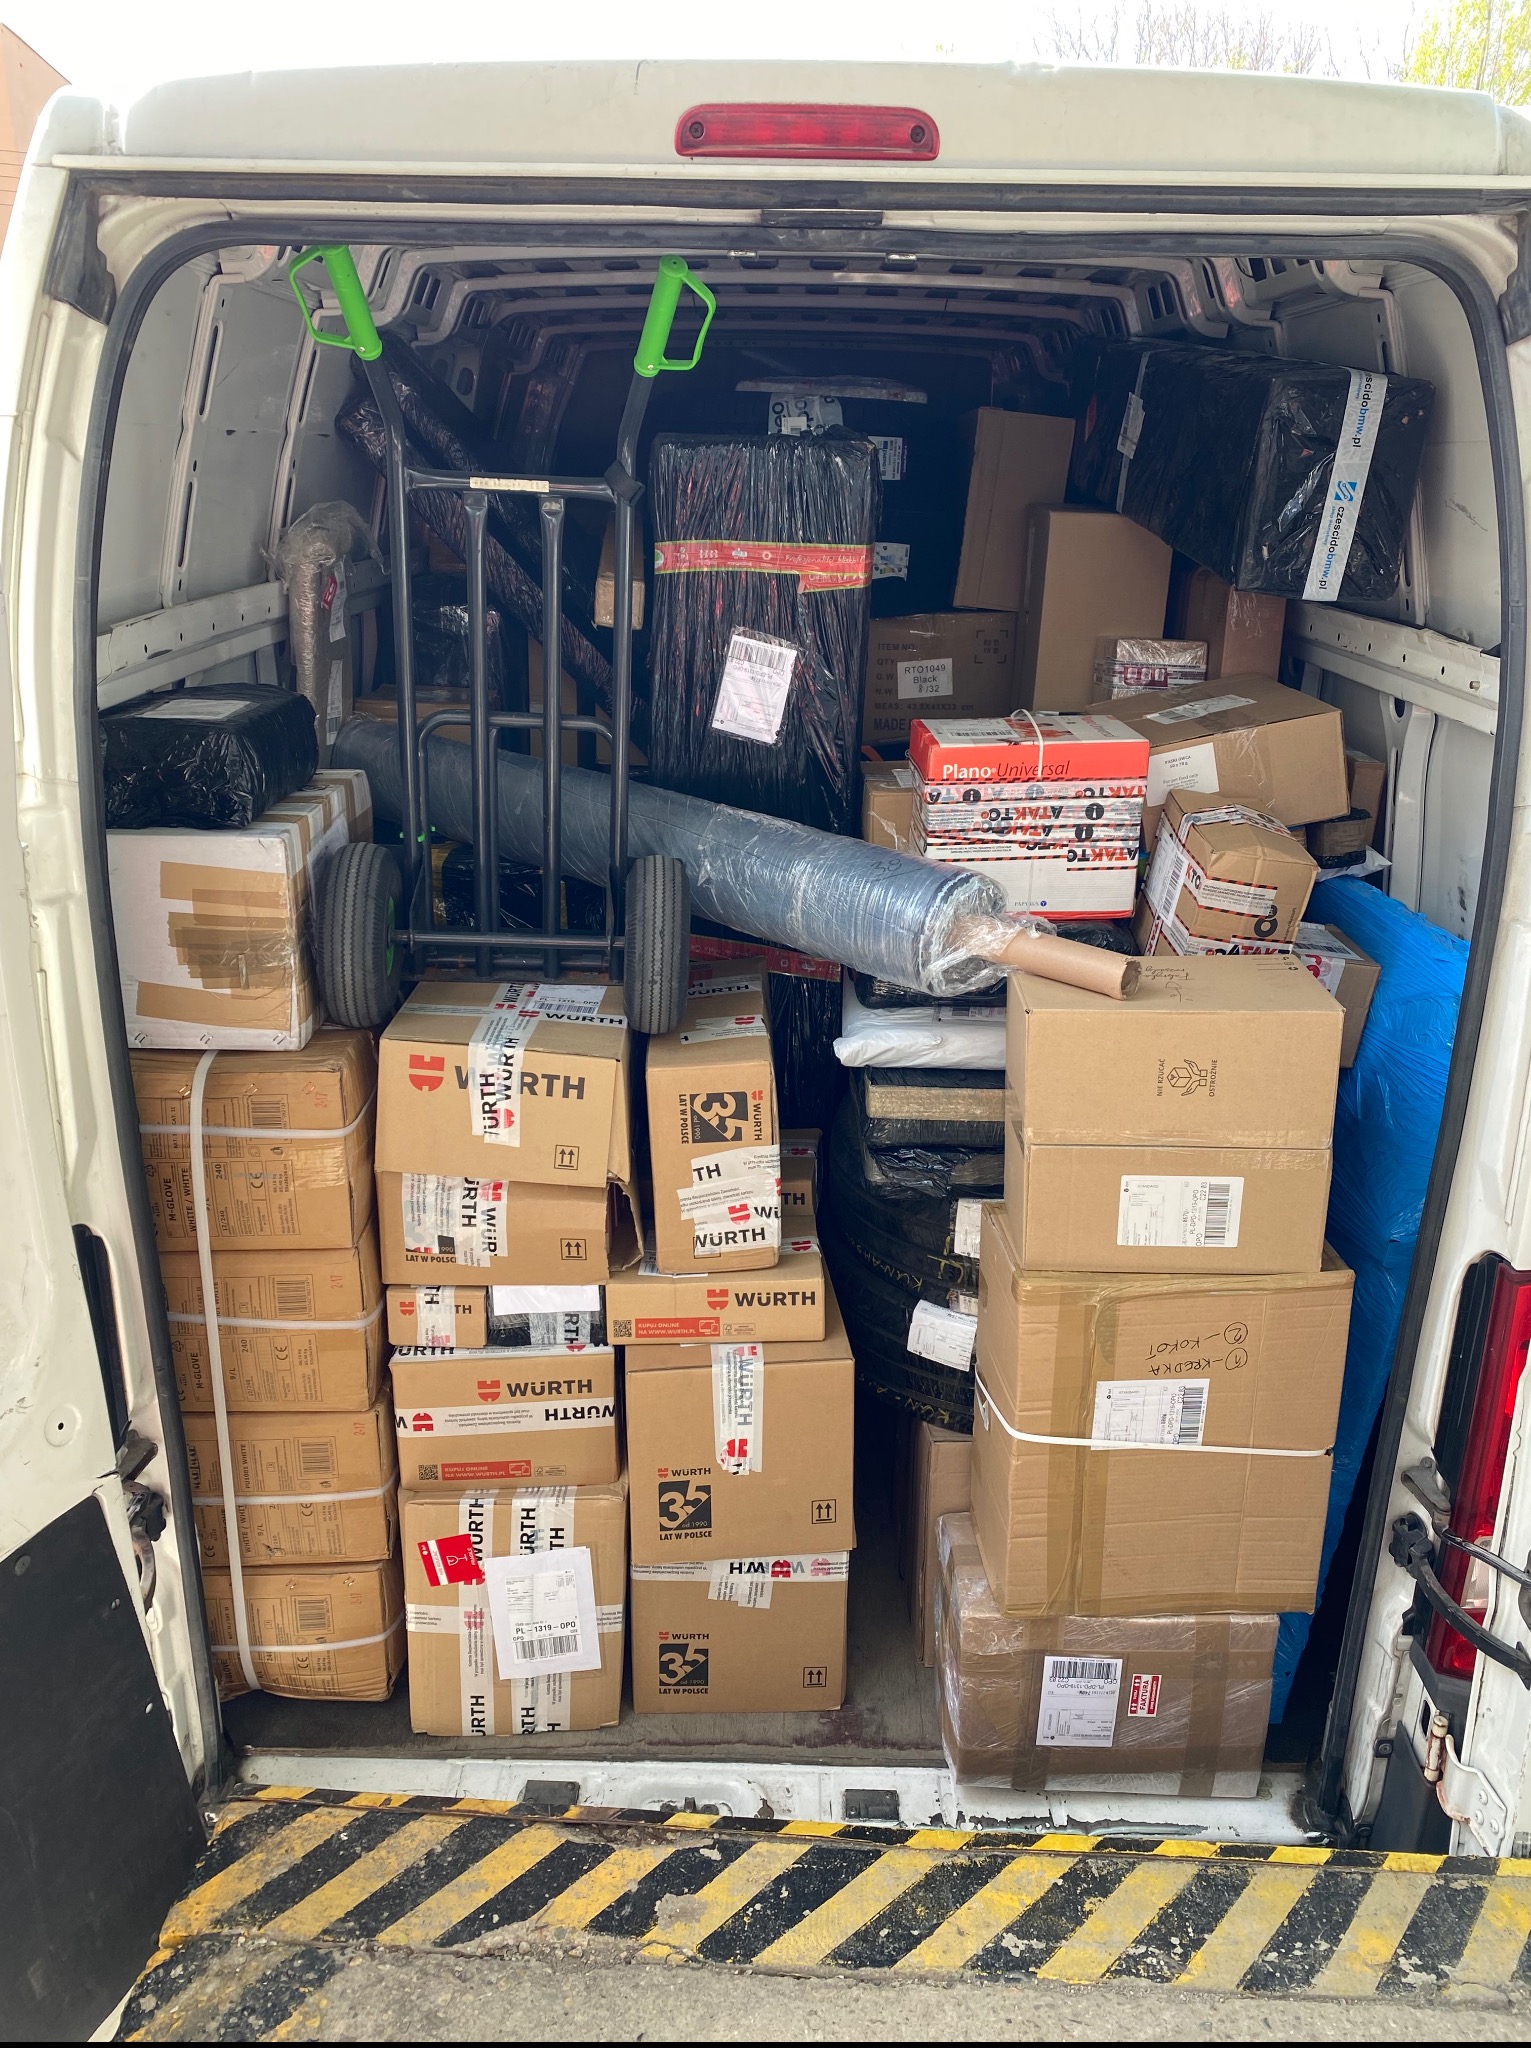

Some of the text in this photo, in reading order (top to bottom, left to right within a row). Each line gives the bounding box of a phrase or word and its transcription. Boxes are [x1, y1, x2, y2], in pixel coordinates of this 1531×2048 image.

[1318, 506, 1345, 590] czescidobmw.pl
[904, 664, 946, 674] RTO1049
[913, 676, 938, 684] Black
[873, 718, 906, 731] MADE
[943, 759, 1071, 779] Plano Universal
[1158, 1058, 1166, 1085] RZUCAĆ
[1208, 1059, 1218, 1097] OSTROŻNIE
[679, 1094, 689, 1144] LAT W POLSCE
[753, 1103, 762, 1141] WÜRTH
[181, 1168, 191, 1196] WHITE
[214, 1164, 223, 1180] 240
[163, 1178, 176, 1221] M-GLOVE
[461, 1176, 477, 1228] ÜRTH
[185, 1205, 196, 1232] WHITE
[695, 1227, 766, 1248] WÜRTH
[430, 1255, 457, 1263] POLSC
[734, 1291, 816, 1307] WÜRTH
[241, 1339, 249, 1353] 240
[1145, 1328, 1242, 1360] 2 KOKOT
[190, 1352, 204, 1389] M-GLOVE
[1148, 1357, 1211, 1376] KREDKA
[507, 1380, 593, 1398] WÜRTH
[545, 1404, 616, 1422] WÜRTH
[240, 1443, 249, 1465] WHITE
[671, 1468, 711, 1477] WÜRTH
[520, 1507, 536, 1555] ÜRTH
[660, 1533, 673, 1541] LAT
[684, 1531, 712, 1539] POLSCE
[243, 1531, 252, 1554] WHITE
[466, 1547, 478, 1566] FRAGILE
[515, 1627, 526, 1635] PL
[534, 1624, 553, 1633] 1319
[1139, 1679, 1150, 1711] FAKTURA
[470, 1695, 486, 1736] ÜRTH
